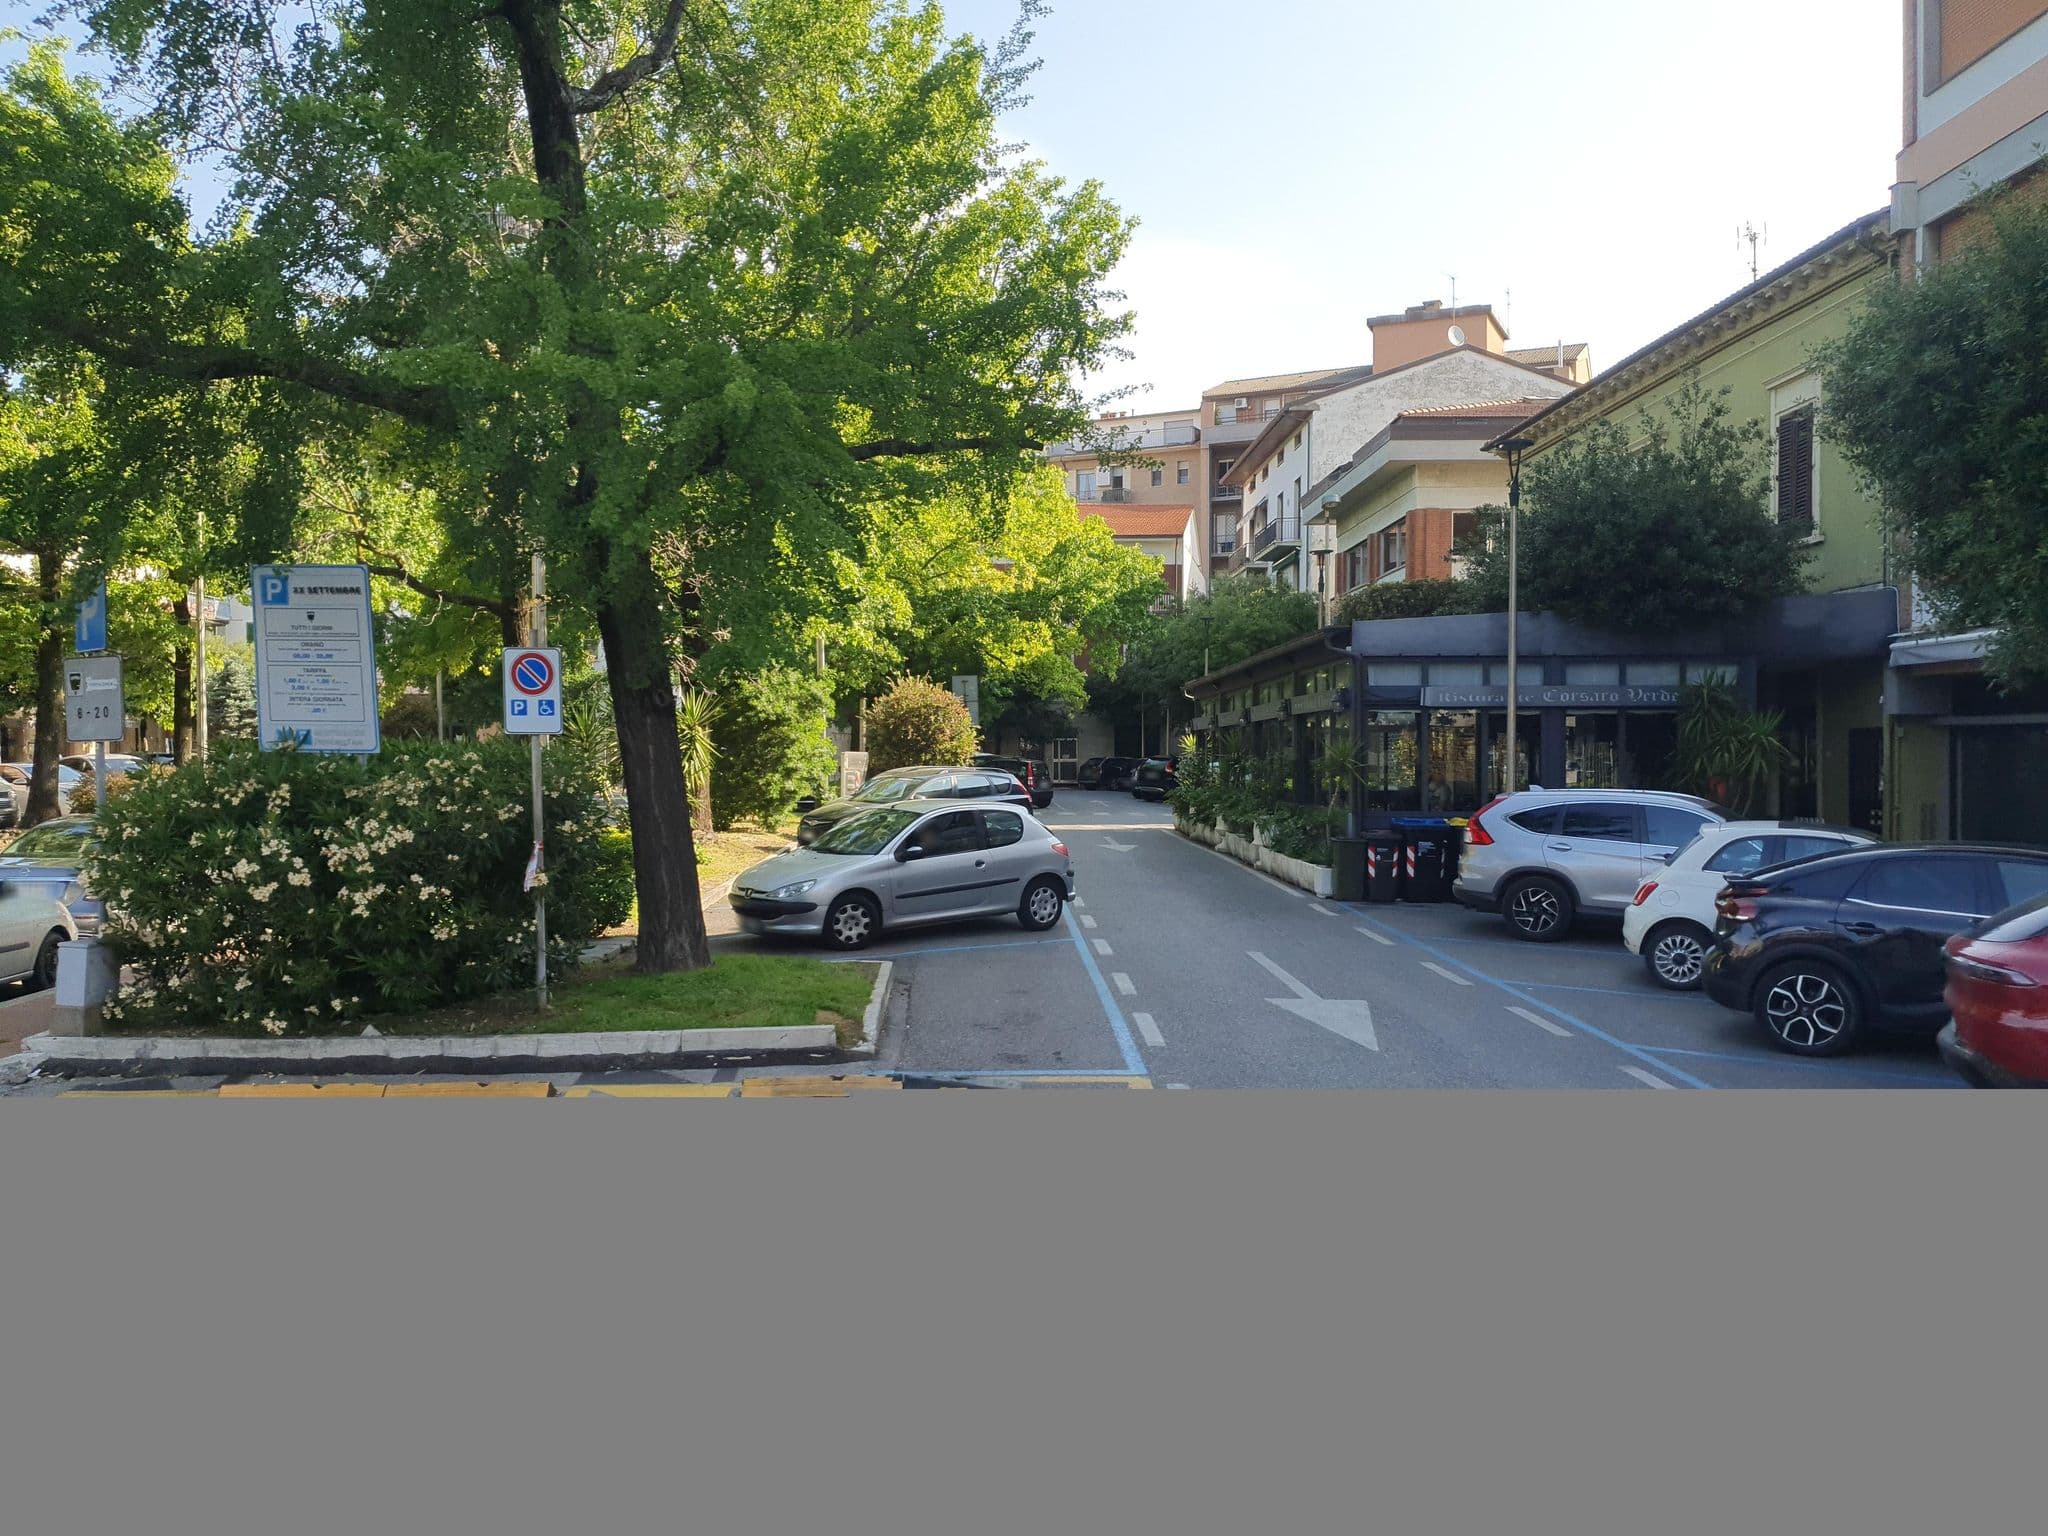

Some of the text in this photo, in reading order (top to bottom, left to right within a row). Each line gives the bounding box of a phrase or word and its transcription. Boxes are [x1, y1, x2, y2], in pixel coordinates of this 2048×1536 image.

[266, 579, 283, 601] P
[307, 586, 362, 595] SETTEMBRE
[1438, 688, 1680, 704] Ristorate Corsaro Verde
[514, 701, 524, 714] P
